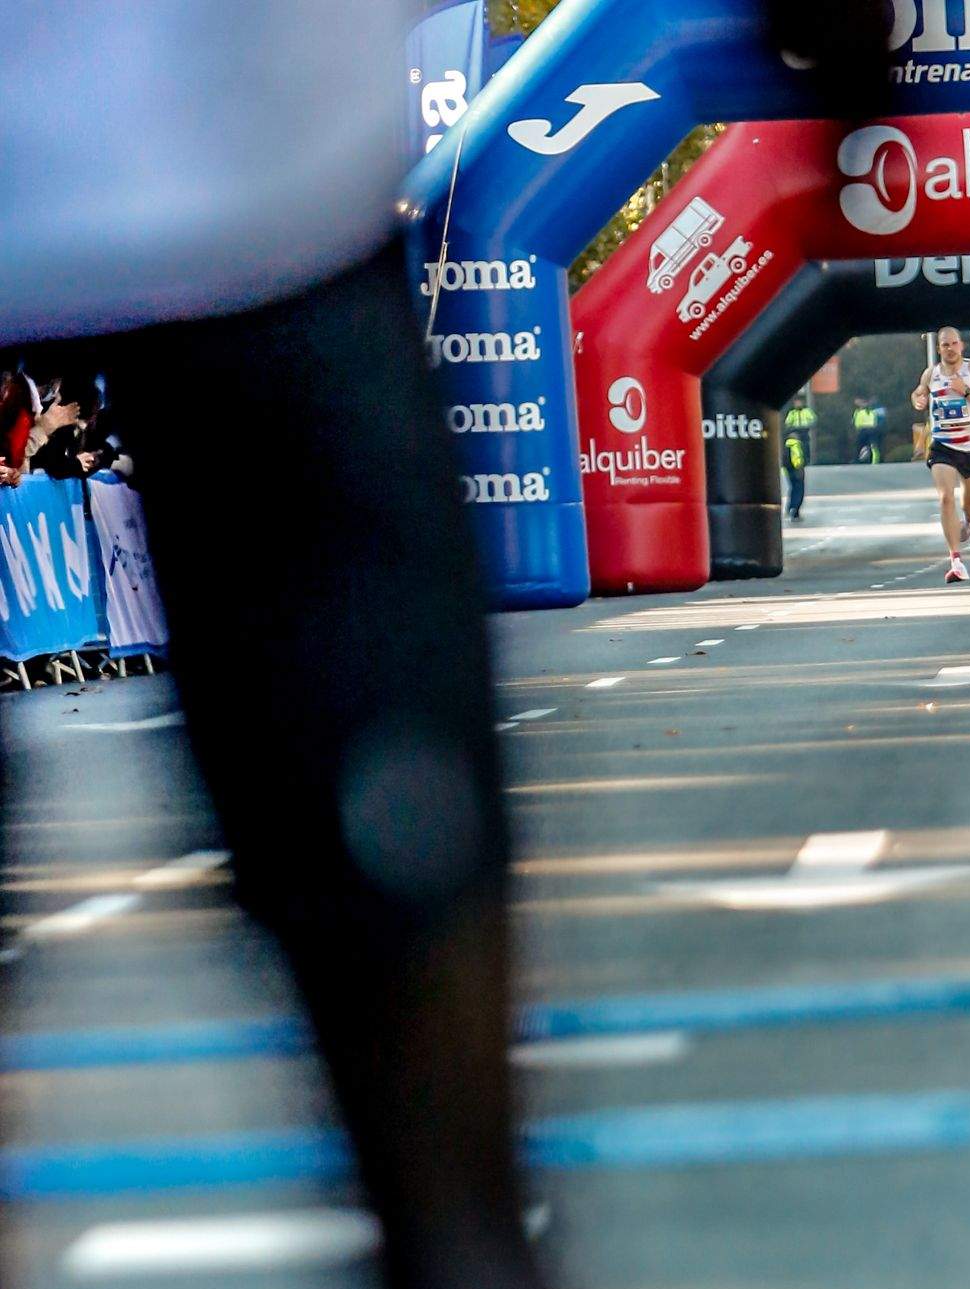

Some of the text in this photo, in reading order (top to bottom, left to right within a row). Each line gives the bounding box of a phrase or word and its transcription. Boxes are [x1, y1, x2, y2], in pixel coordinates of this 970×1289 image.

[446, 401, 545, 433] oma
[701, 413, 768, 439] oitte.
[580, 436, 685, 486] alquiber
